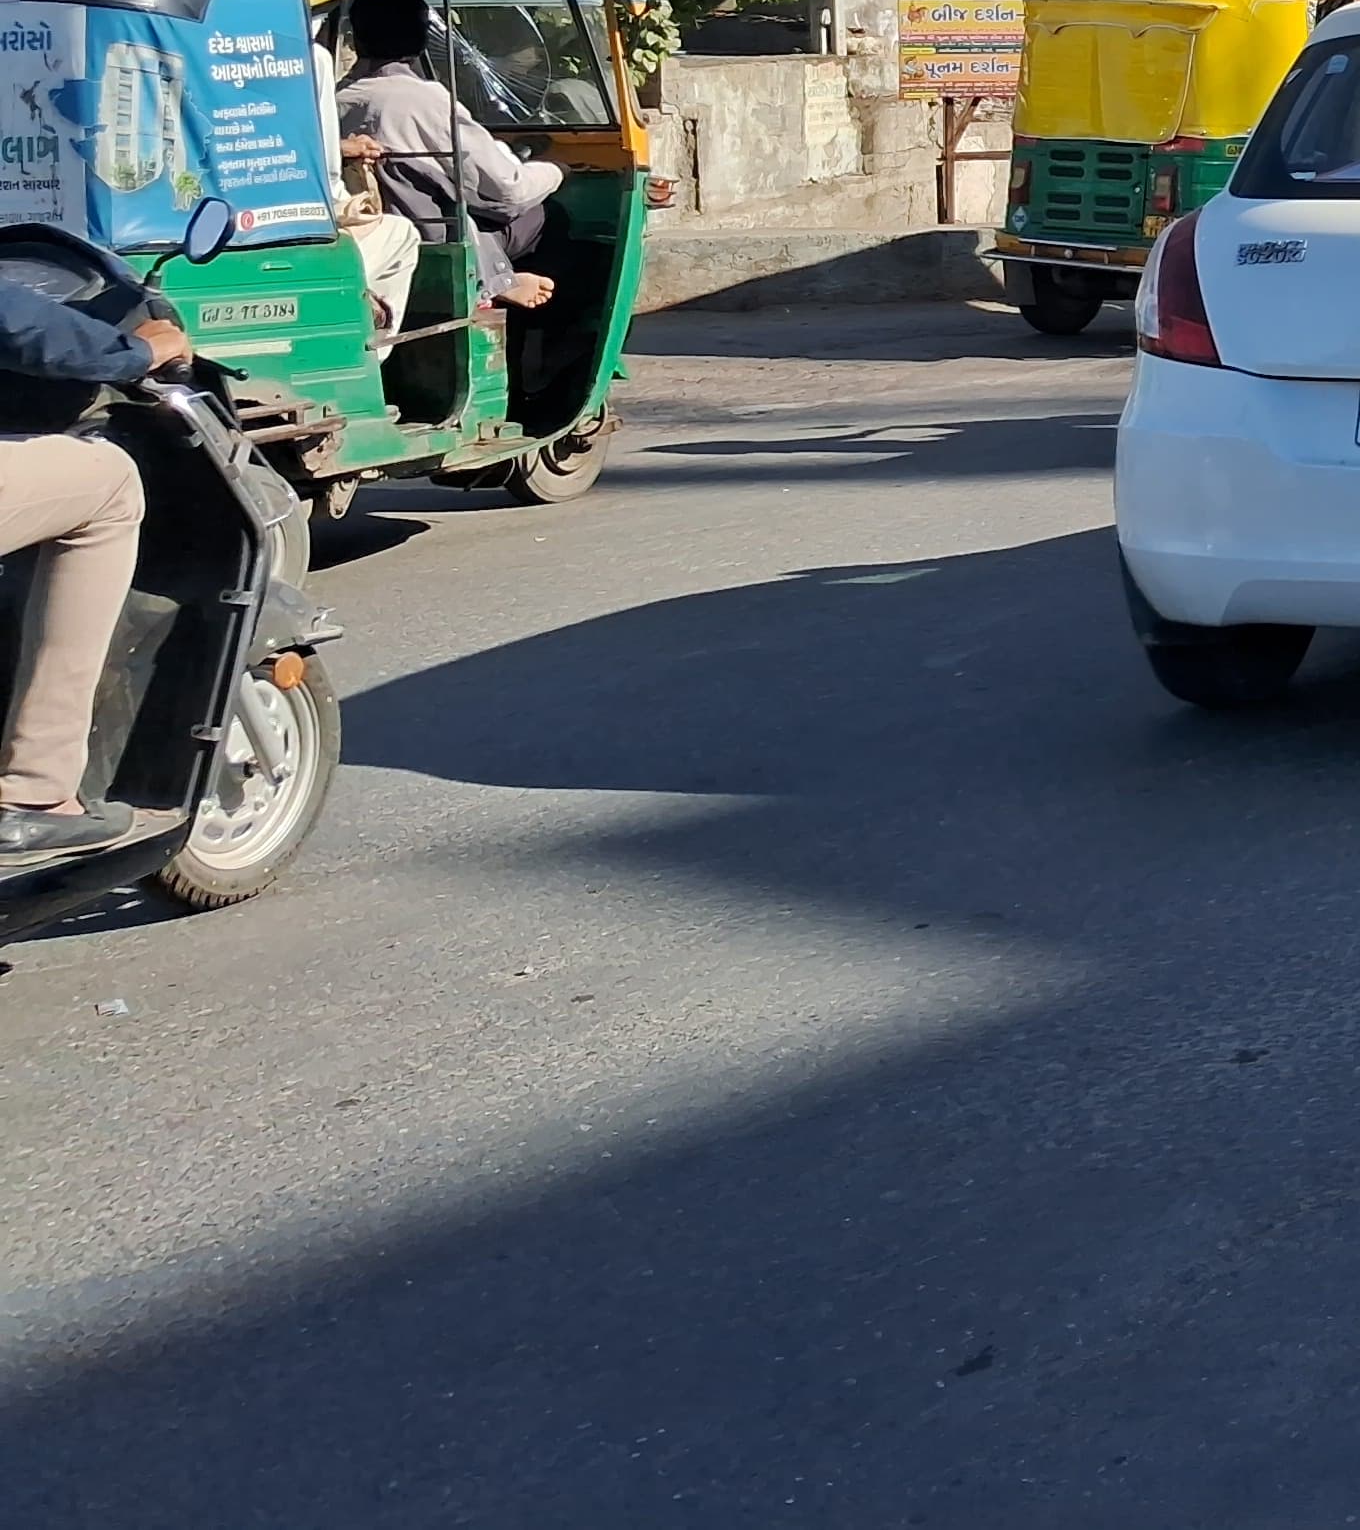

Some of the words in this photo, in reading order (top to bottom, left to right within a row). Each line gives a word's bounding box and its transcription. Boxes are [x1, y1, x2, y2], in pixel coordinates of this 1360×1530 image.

[931, 3, 968, 22] બીજ
[974, 3, 1014, 22] દર્શન
[208, 30, 234, 55] દરેક
[235, 29, 275, 54] શ્વાસમાં
[210, 55, 264, 89] આયુષનો
[263, 54, 305, 79] વિશ્વાસ
[924, 61, 963, 79] પૂનમ
[970, 56, 1009, 73] દર્શન
